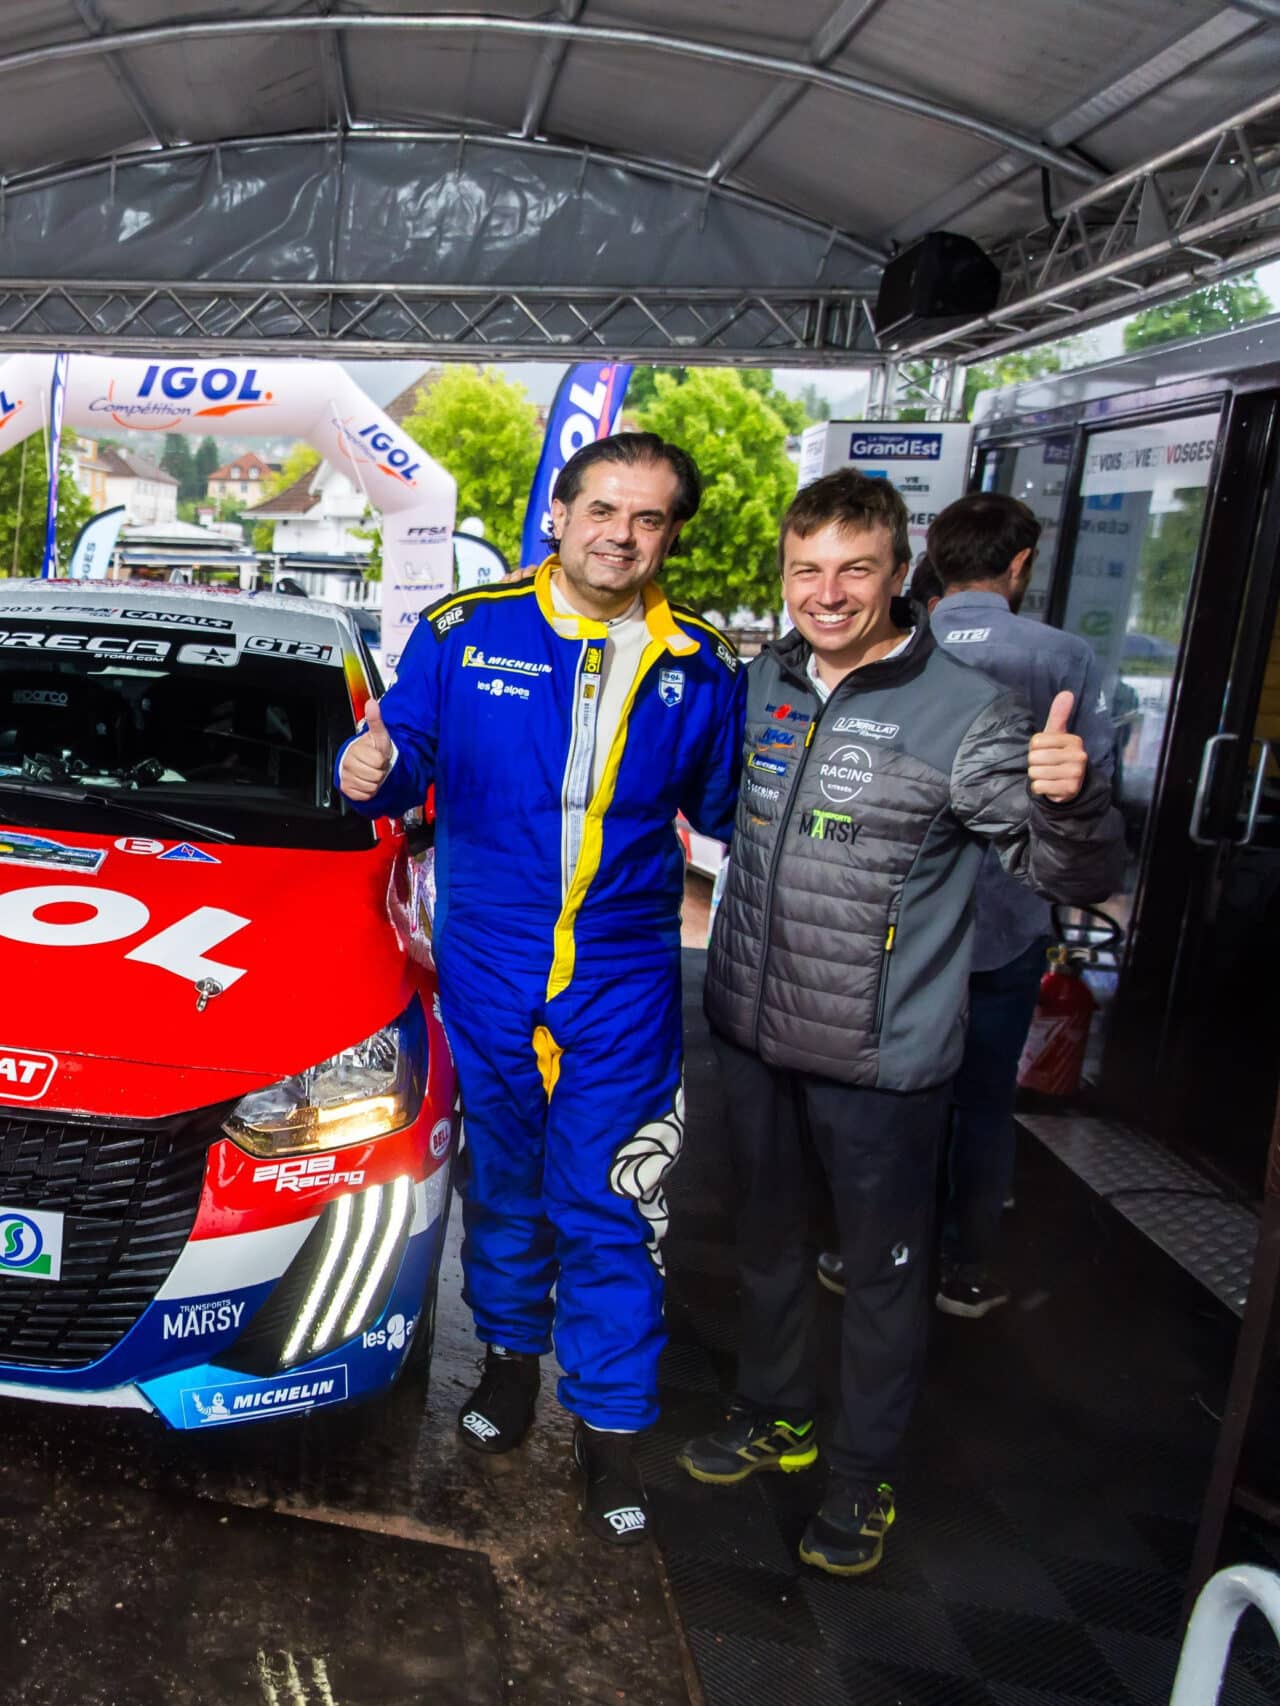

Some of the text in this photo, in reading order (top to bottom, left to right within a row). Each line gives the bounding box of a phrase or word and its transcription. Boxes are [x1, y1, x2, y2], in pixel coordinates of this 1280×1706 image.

[137, 366, 261, 401] IGOL
[88, 397, 192, 417] Compétition
[359, 424, 421, 480] IGOL
[1100, 452, 1122, 472] VOIS
[1135, 448, 1152, 467] VIE
[1167, 439, 1214, 464] VOSGES
[407, 526, 447, 536] FFSA
[124, 610, 230, 628] CANAL+
[93, 653, 165, 662] STORE.COM
[246, 636, 334, 661] GT2i
[587, 648, 599, 673] OMP
[488, 656, 553, 673] MICHELIN
[503, 684, 530, 698] alpes
[820, 763, 873, 784] RACING
[799, 812, 864, 845] MARSY
[431, 1124, 449, 1152] BELL
[252, 1155, 337, 1183] 208
[275, 1169, 366, 1193] Racing
[180, 1299, 231, 1313] TRANSPORTS
[163, 1302, 246, 1340] MARSY
[362, 1329, 386, 1349] les
[386, 1314, 406, 1351] 2
[233, 1379, 335, 1409] MICHELIN
[463, 1414, 496, 1438] OMP
[610, 1511, 647, 1531] OMP
